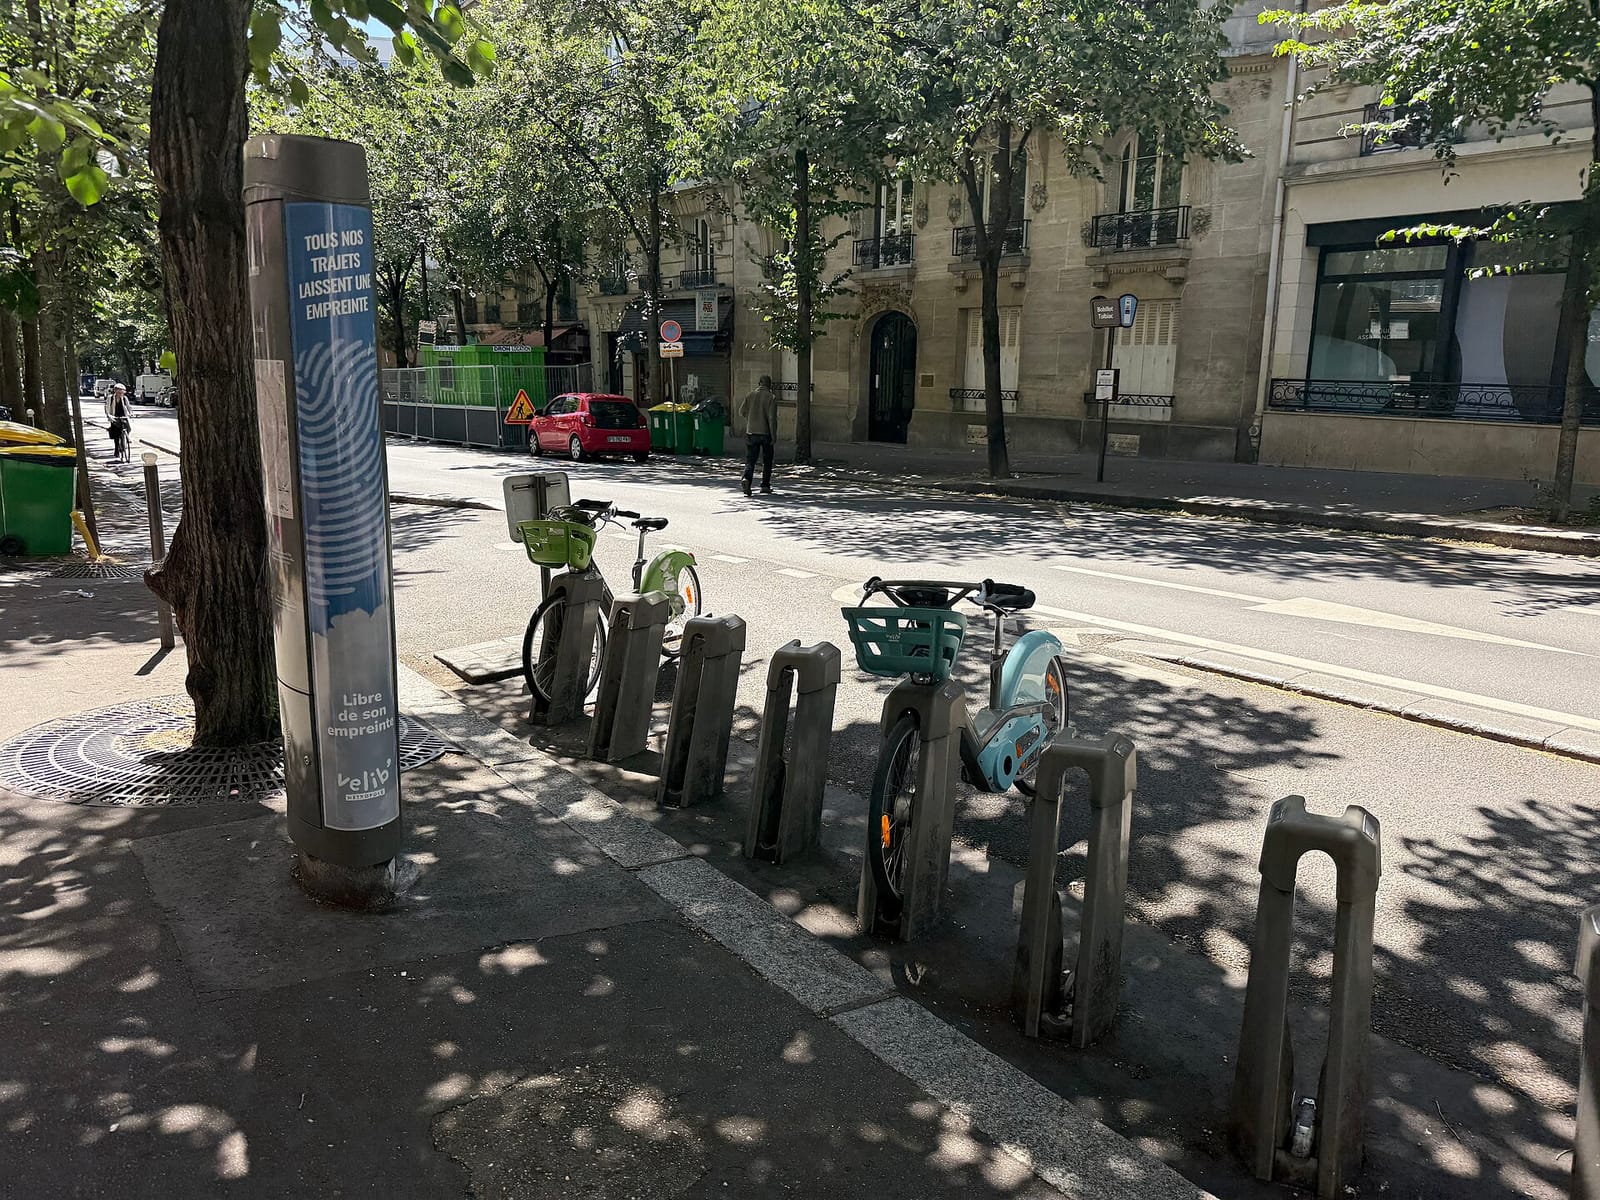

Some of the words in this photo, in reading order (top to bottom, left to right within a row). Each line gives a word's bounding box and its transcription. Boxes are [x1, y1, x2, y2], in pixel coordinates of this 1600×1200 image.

[304, 232, 338, 251] TOUS
[341, 229, 364, 247] NOS
[311, 252, 361, 273] TRAJETS
[298, 276, 353, 299] LAISSENT
[355, 273, 371, 290] UNE
[306, 296, 369, 320] EMPREINTE
[343, 692, 382, 706] Libre
[338, 710, 358, 721] de
[362, 706, 387, 720] son
